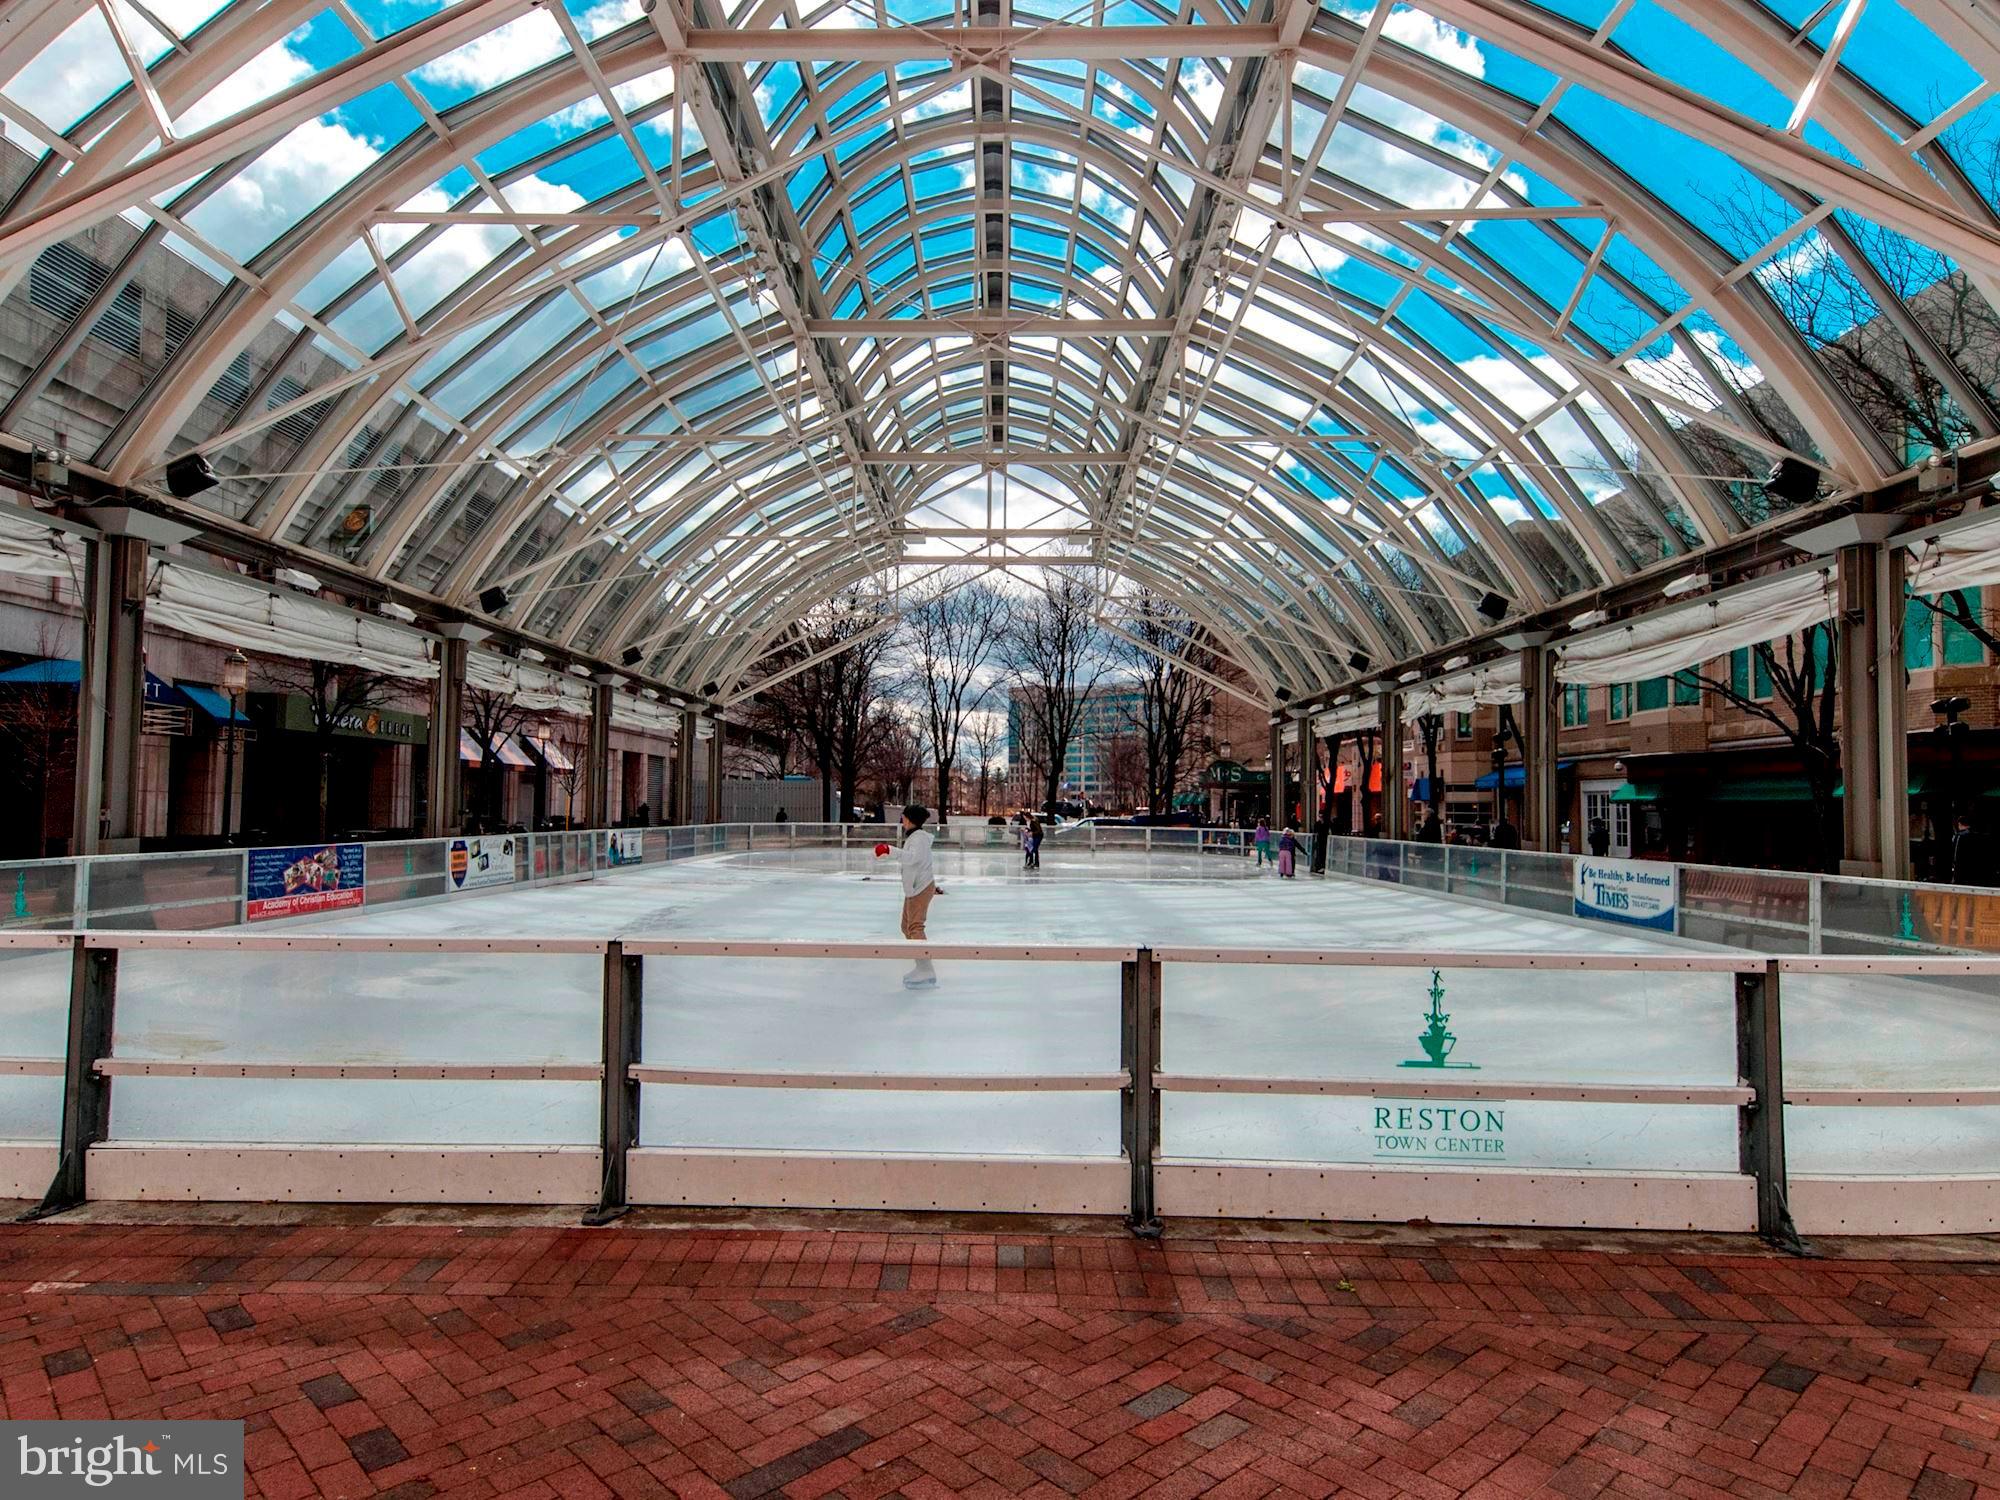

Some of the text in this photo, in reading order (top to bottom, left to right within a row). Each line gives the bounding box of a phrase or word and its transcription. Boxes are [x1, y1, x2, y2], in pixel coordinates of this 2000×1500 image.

[1588, 868, 1670, 886] Be Healthy, Be Informed
[262, 899, 291, 910] Academy
[292, 898, 299, 906] of
[300, 894, 326, 905] Christian
[327, 891, 353, 902] Education
[1593, 882, 1629, 910] TIMES
[1374, 1107, 1505, 1132] RESTON
[1375, 1135, 1505, 1153] TOWN CENTER
